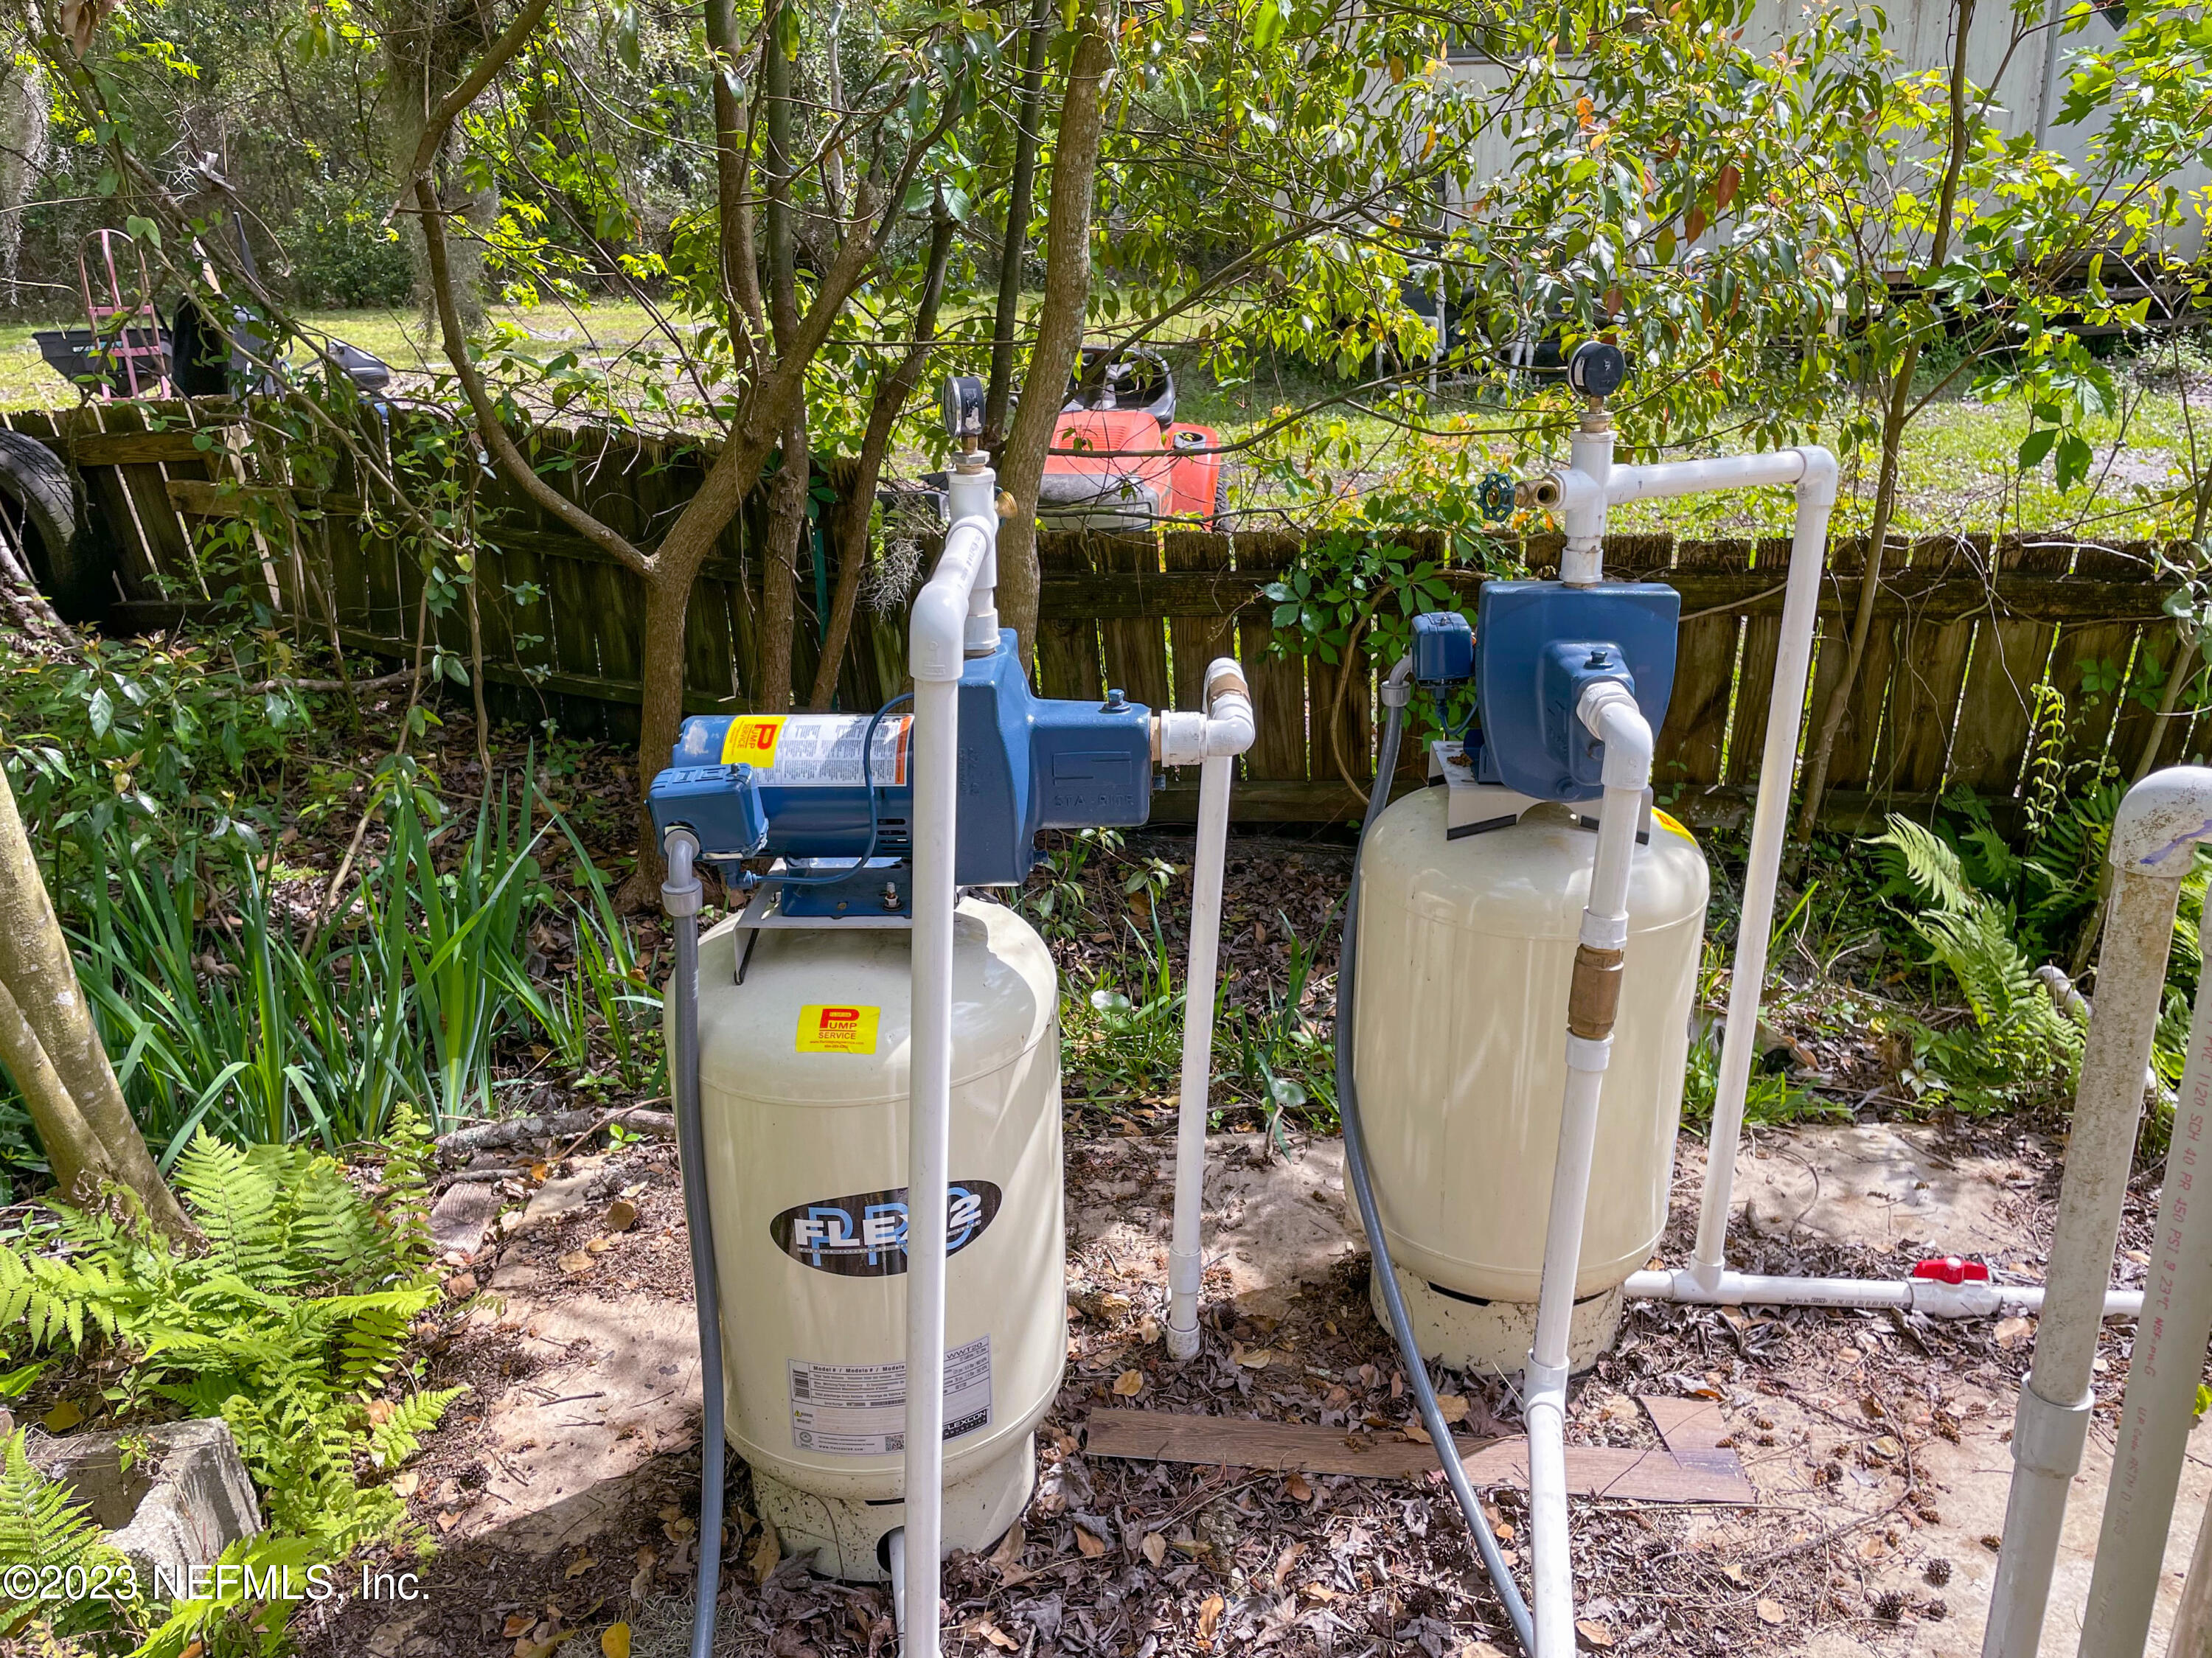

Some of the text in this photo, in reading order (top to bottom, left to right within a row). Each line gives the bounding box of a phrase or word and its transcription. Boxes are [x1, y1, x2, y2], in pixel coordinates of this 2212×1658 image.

[749, 724, 778, 750] PUMP
[820, 1009, 860, 1029] PUMP
[2194, 1073, 2211, 1107] 1120
[2186, 1113, 2203, 1142] SCH
[2183, 1147, 2197, 1166] 40
[2178, 1171, 2193, 1191] PR
[2166, 1227, 2183, 1254] PSI
